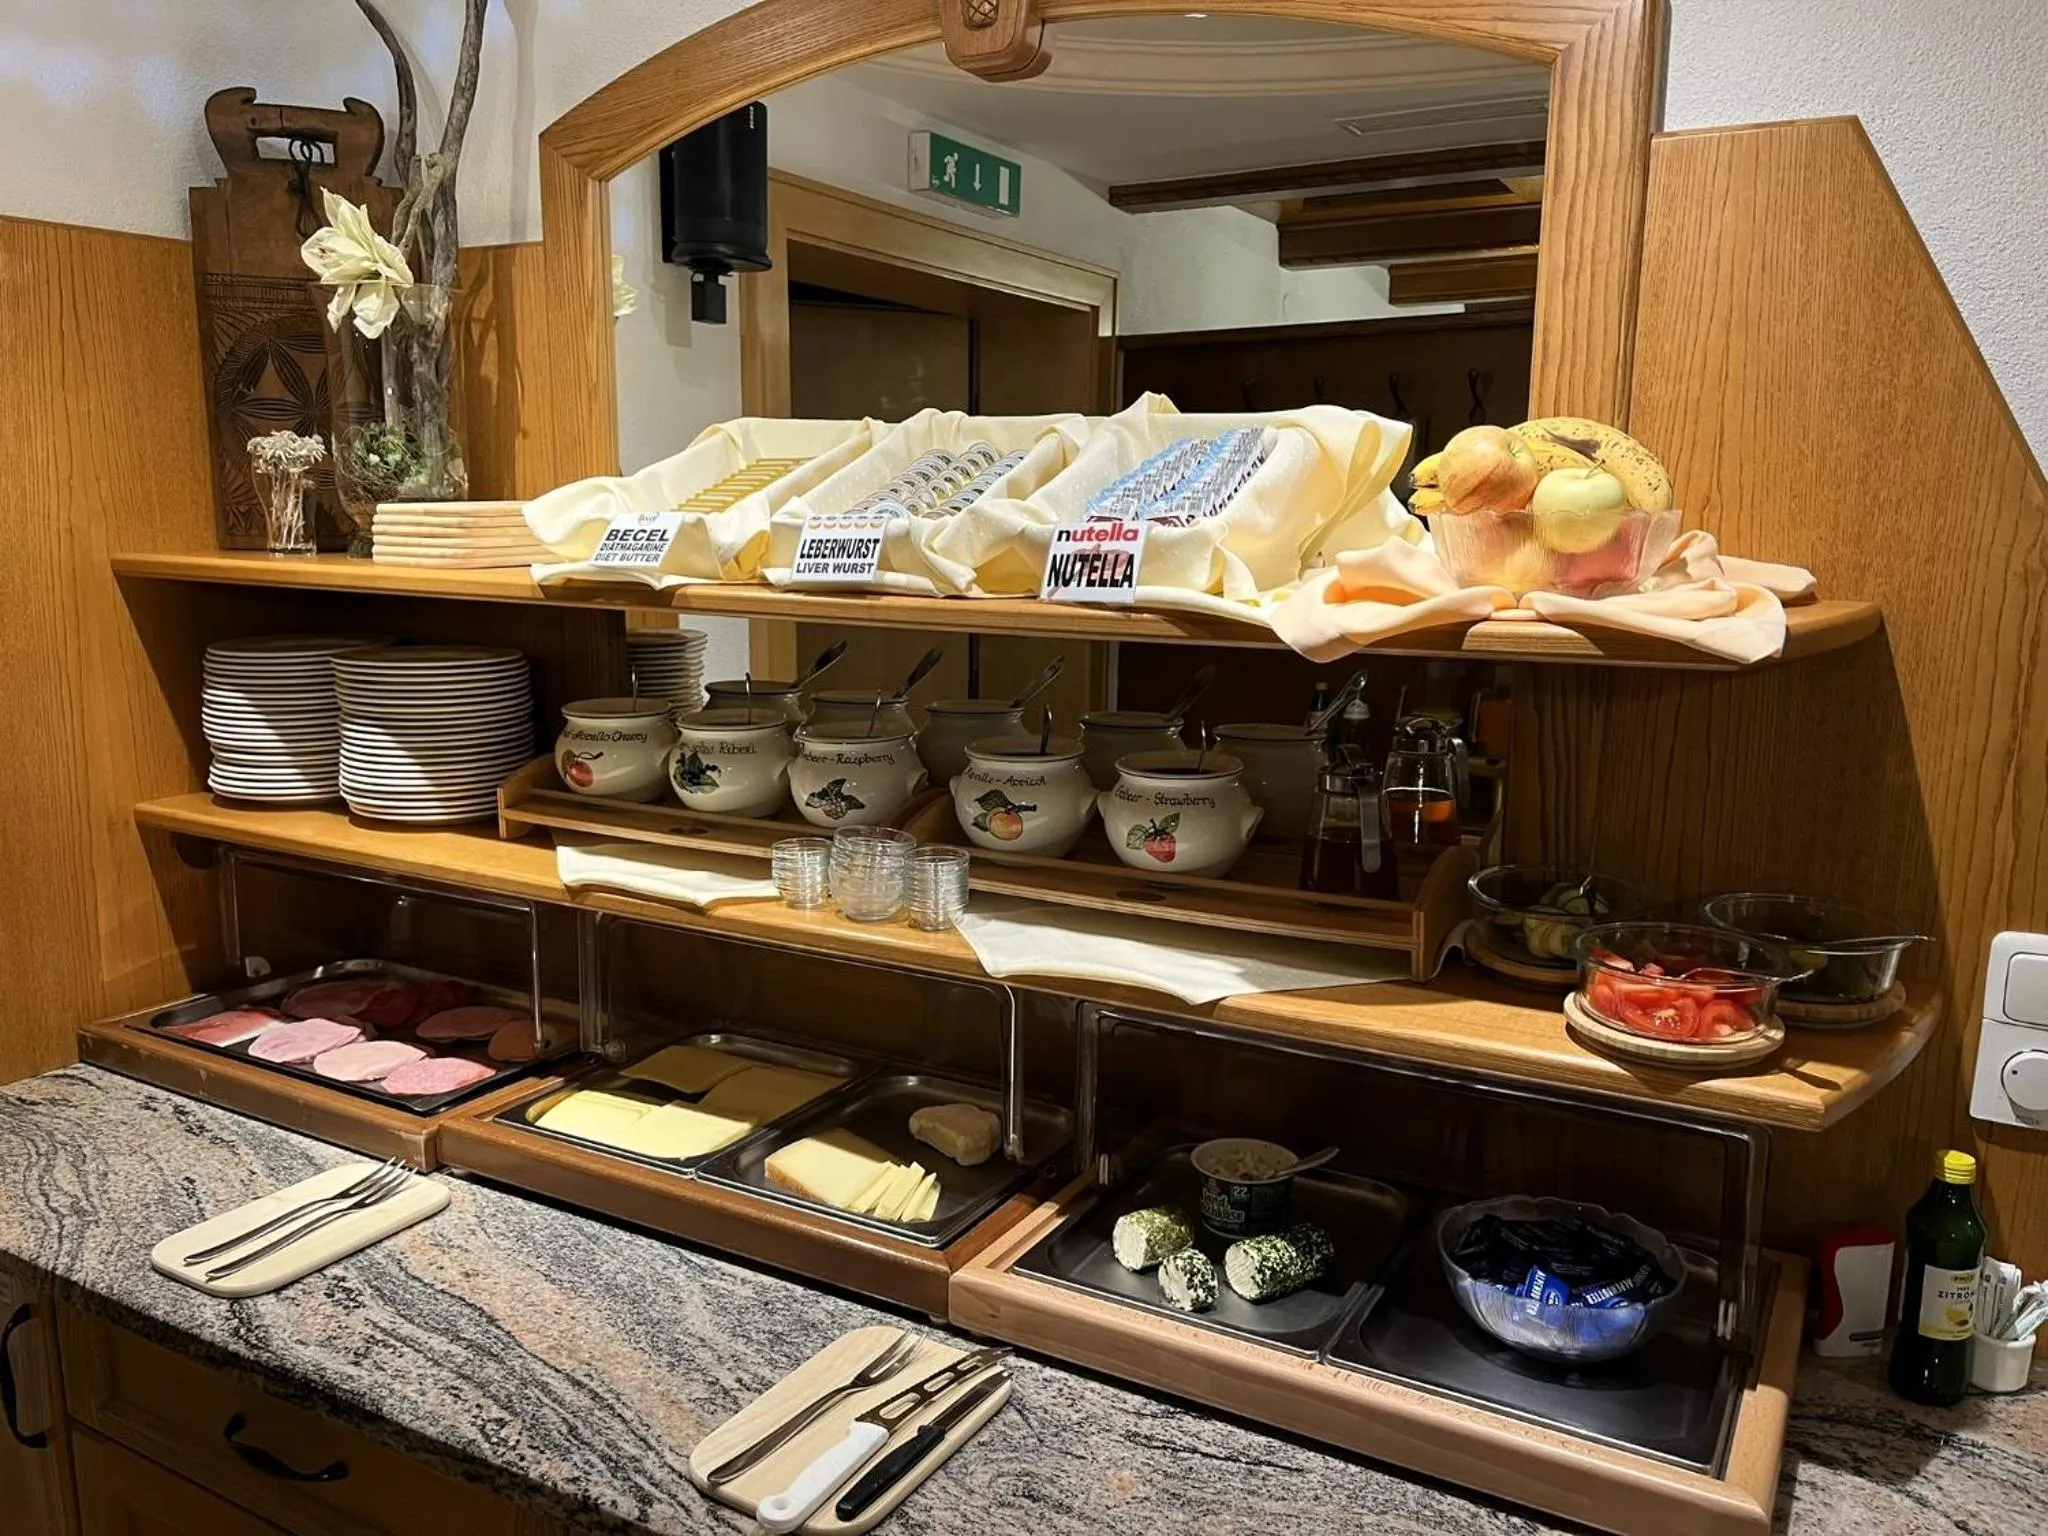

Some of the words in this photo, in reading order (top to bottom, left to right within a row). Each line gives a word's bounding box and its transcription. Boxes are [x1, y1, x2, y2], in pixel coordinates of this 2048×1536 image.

[605, 529, 669, 541] BECEL
[1057, 523, 1139, 542] nutella
[800, 538, 880, 559] LEBERWURST
[594, 553, 618, 561] DIET
[620, 553, 660, 562] BUTTER
[796, 562, 830, 573] LIVER
[833, 562, 874, 574] WURST
[1047, 553, 1135, 588] NUTELLA
